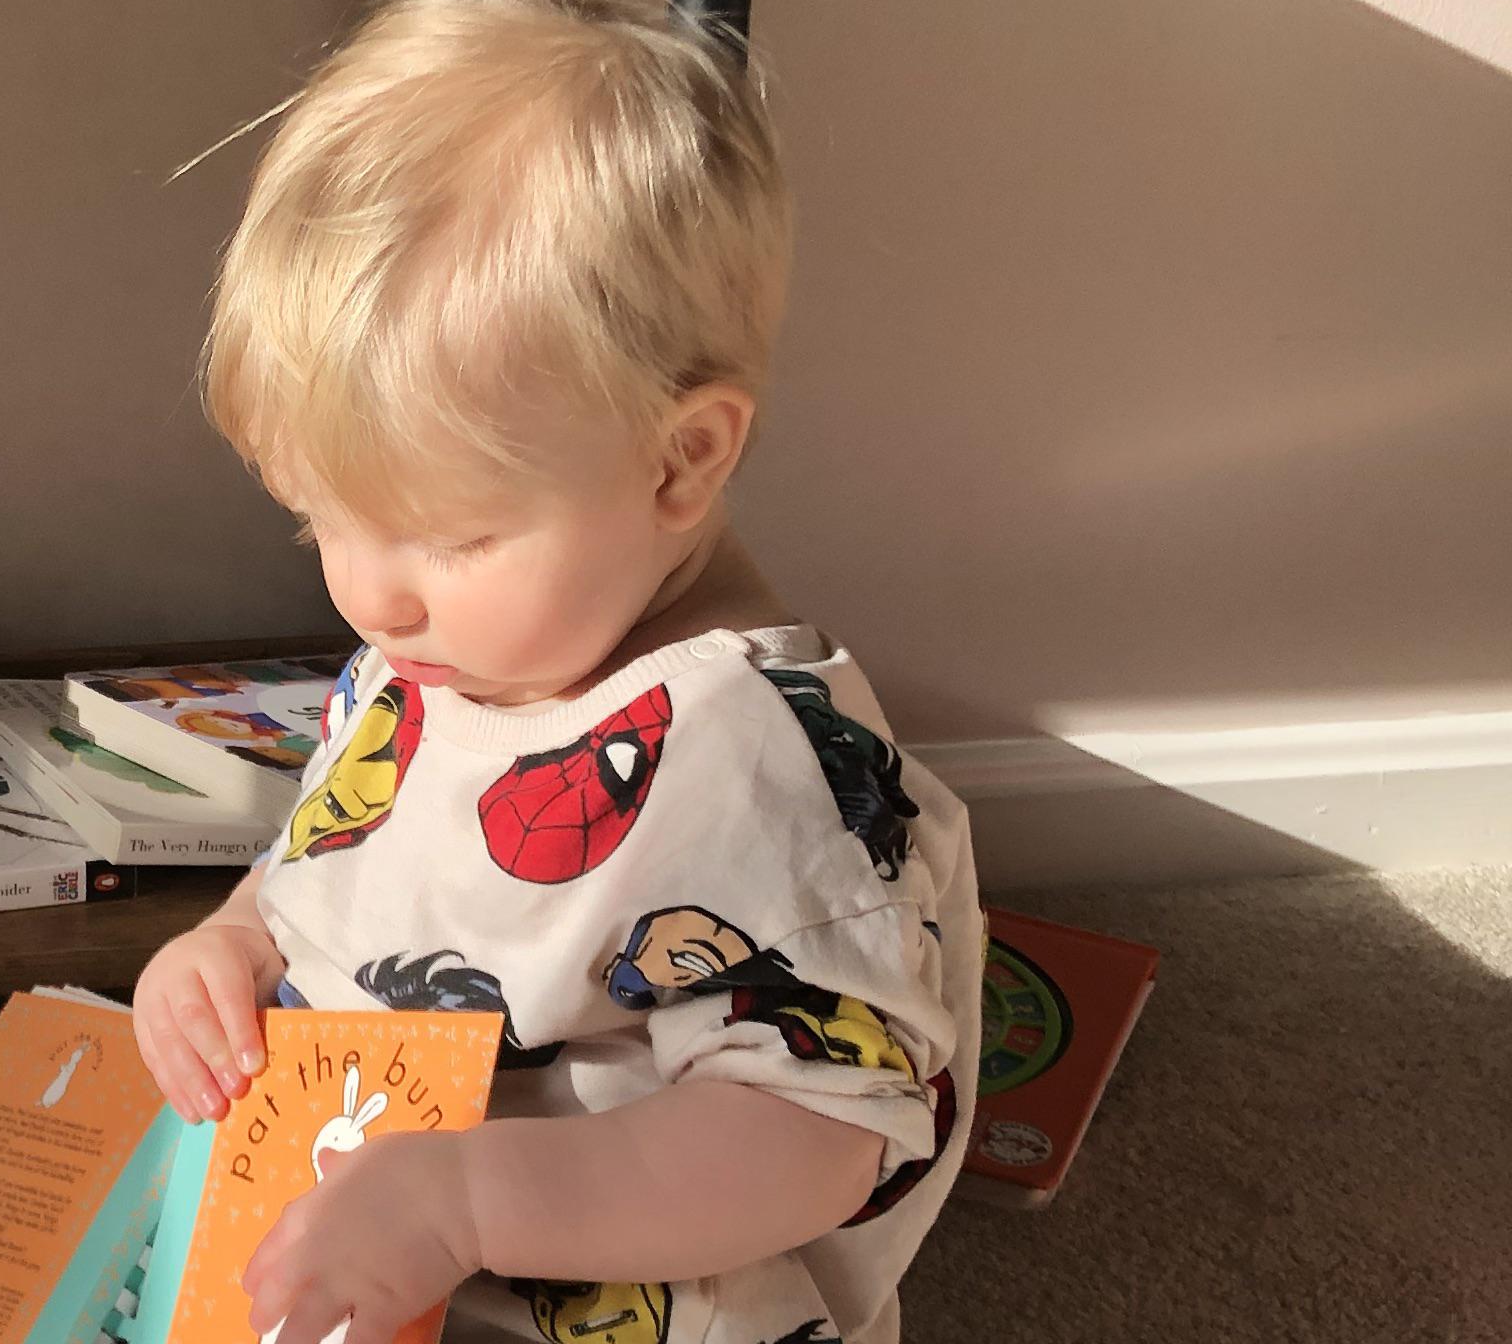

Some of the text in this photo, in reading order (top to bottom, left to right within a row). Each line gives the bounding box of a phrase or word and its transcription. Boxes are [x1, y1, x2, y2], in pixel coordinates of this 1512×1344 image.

[129, 839, 155, 853] The
[160, 839, 190, 855] Very
[197, 839, 248, 855] Hungry
[231, 1042, 446, 1184] pat the bun
